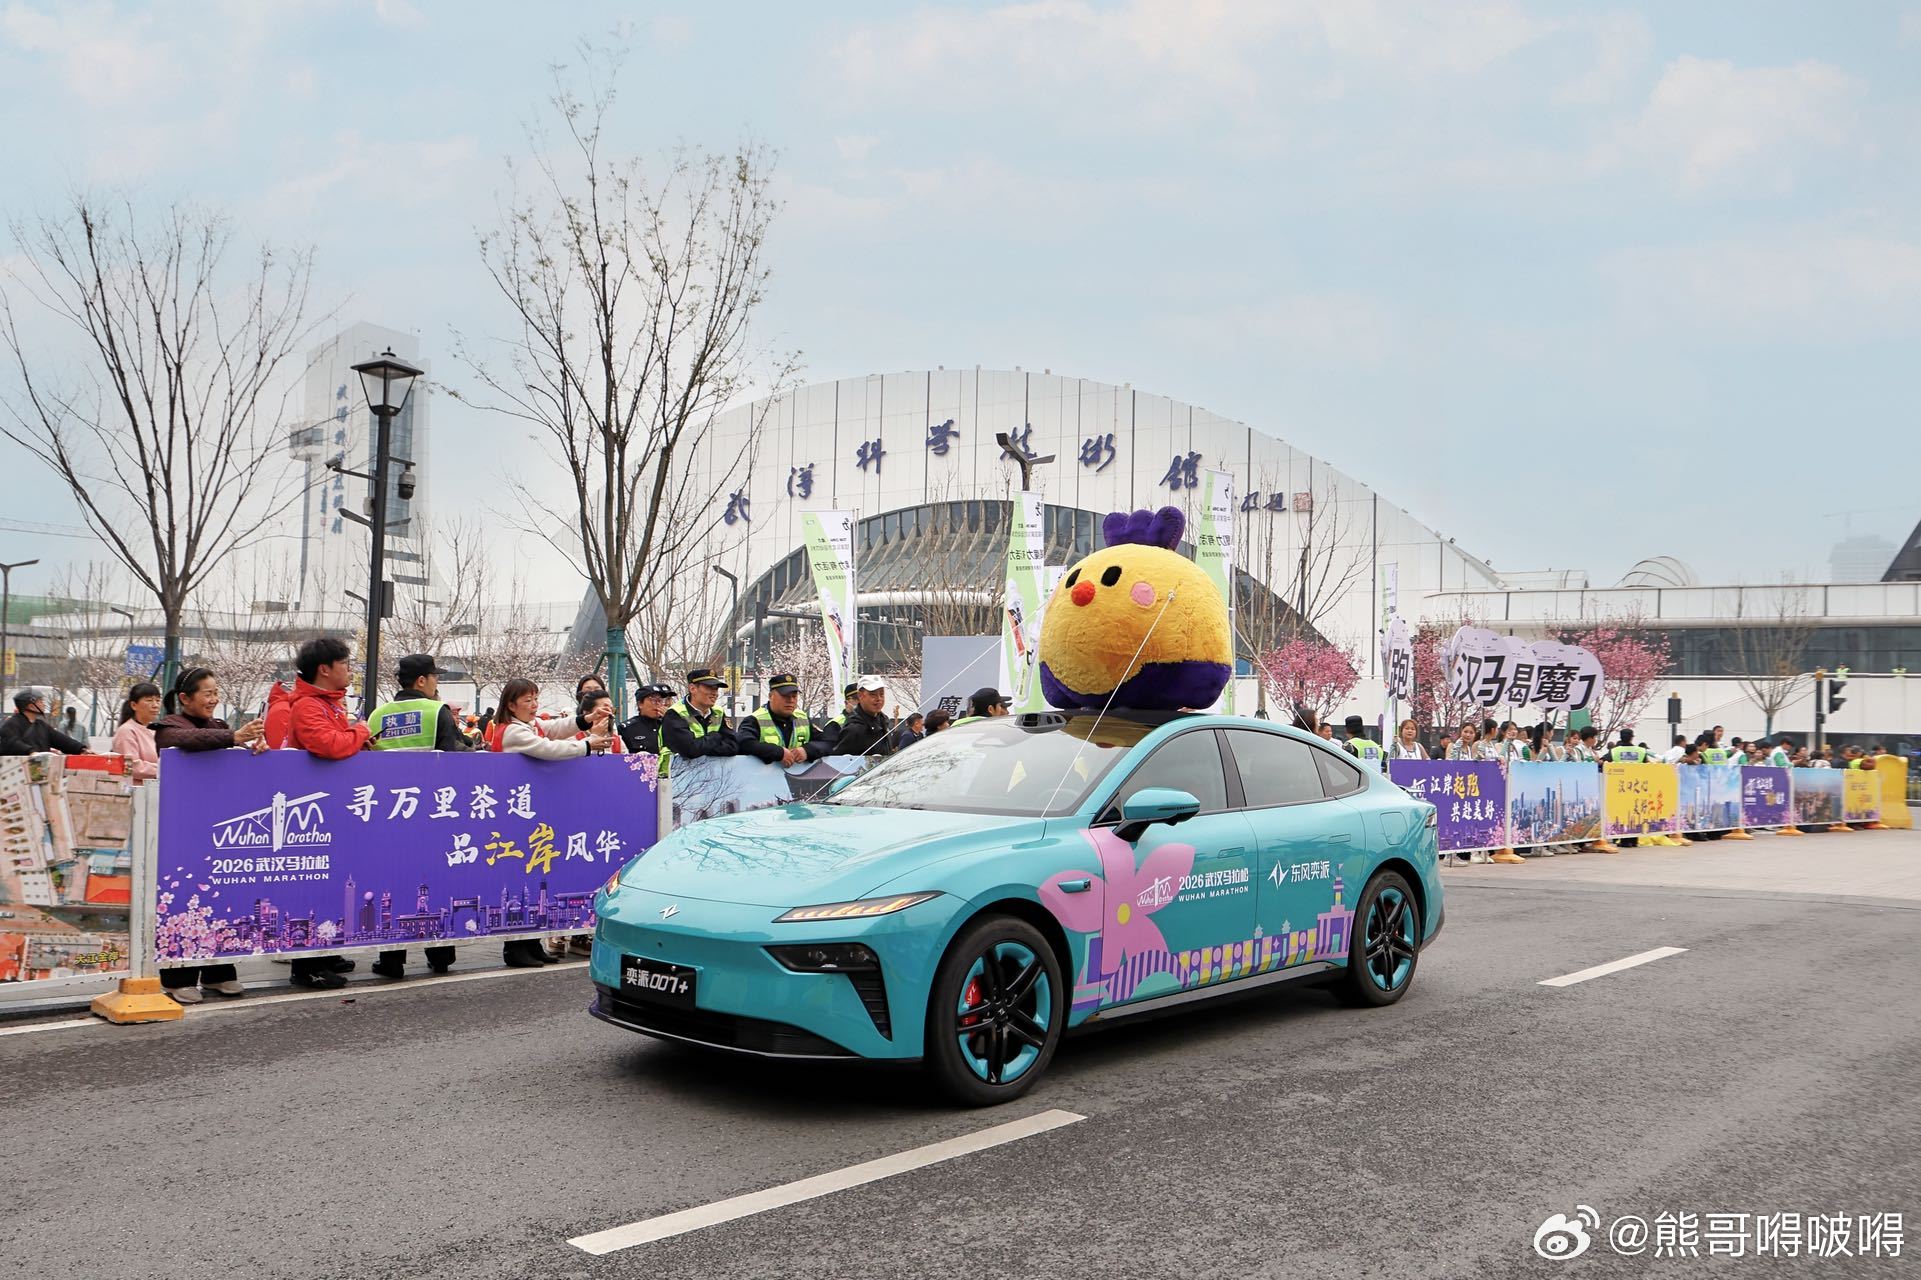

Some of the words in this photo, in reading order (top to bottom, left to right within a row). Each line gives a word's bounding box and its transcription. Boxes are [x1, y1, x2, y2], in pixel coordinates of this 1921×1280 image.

[1389, 648, 1409, 699] 跑
[386, 713, 416, 727] 执勤
[385, 729, 399, 737] ZHI
[346, 783, 537, 823] 寻万里茶道
[1450, 799, 1495, 823] 共赴美好
[212, 820, 270, 848] Wuhan
[445, 822, 621, 875] 品江岸风华
[213, 876, 256, 885] WUHAN
[263, 873, 330, 883] MARATHON
[1291, 860, 1330, 883] 东风奕派
[1178, 893, 1206, 902] WUHAN
[1209, 885, 1249, 897] MARATHON
[626, 967, 689, 994] 奕派007+
